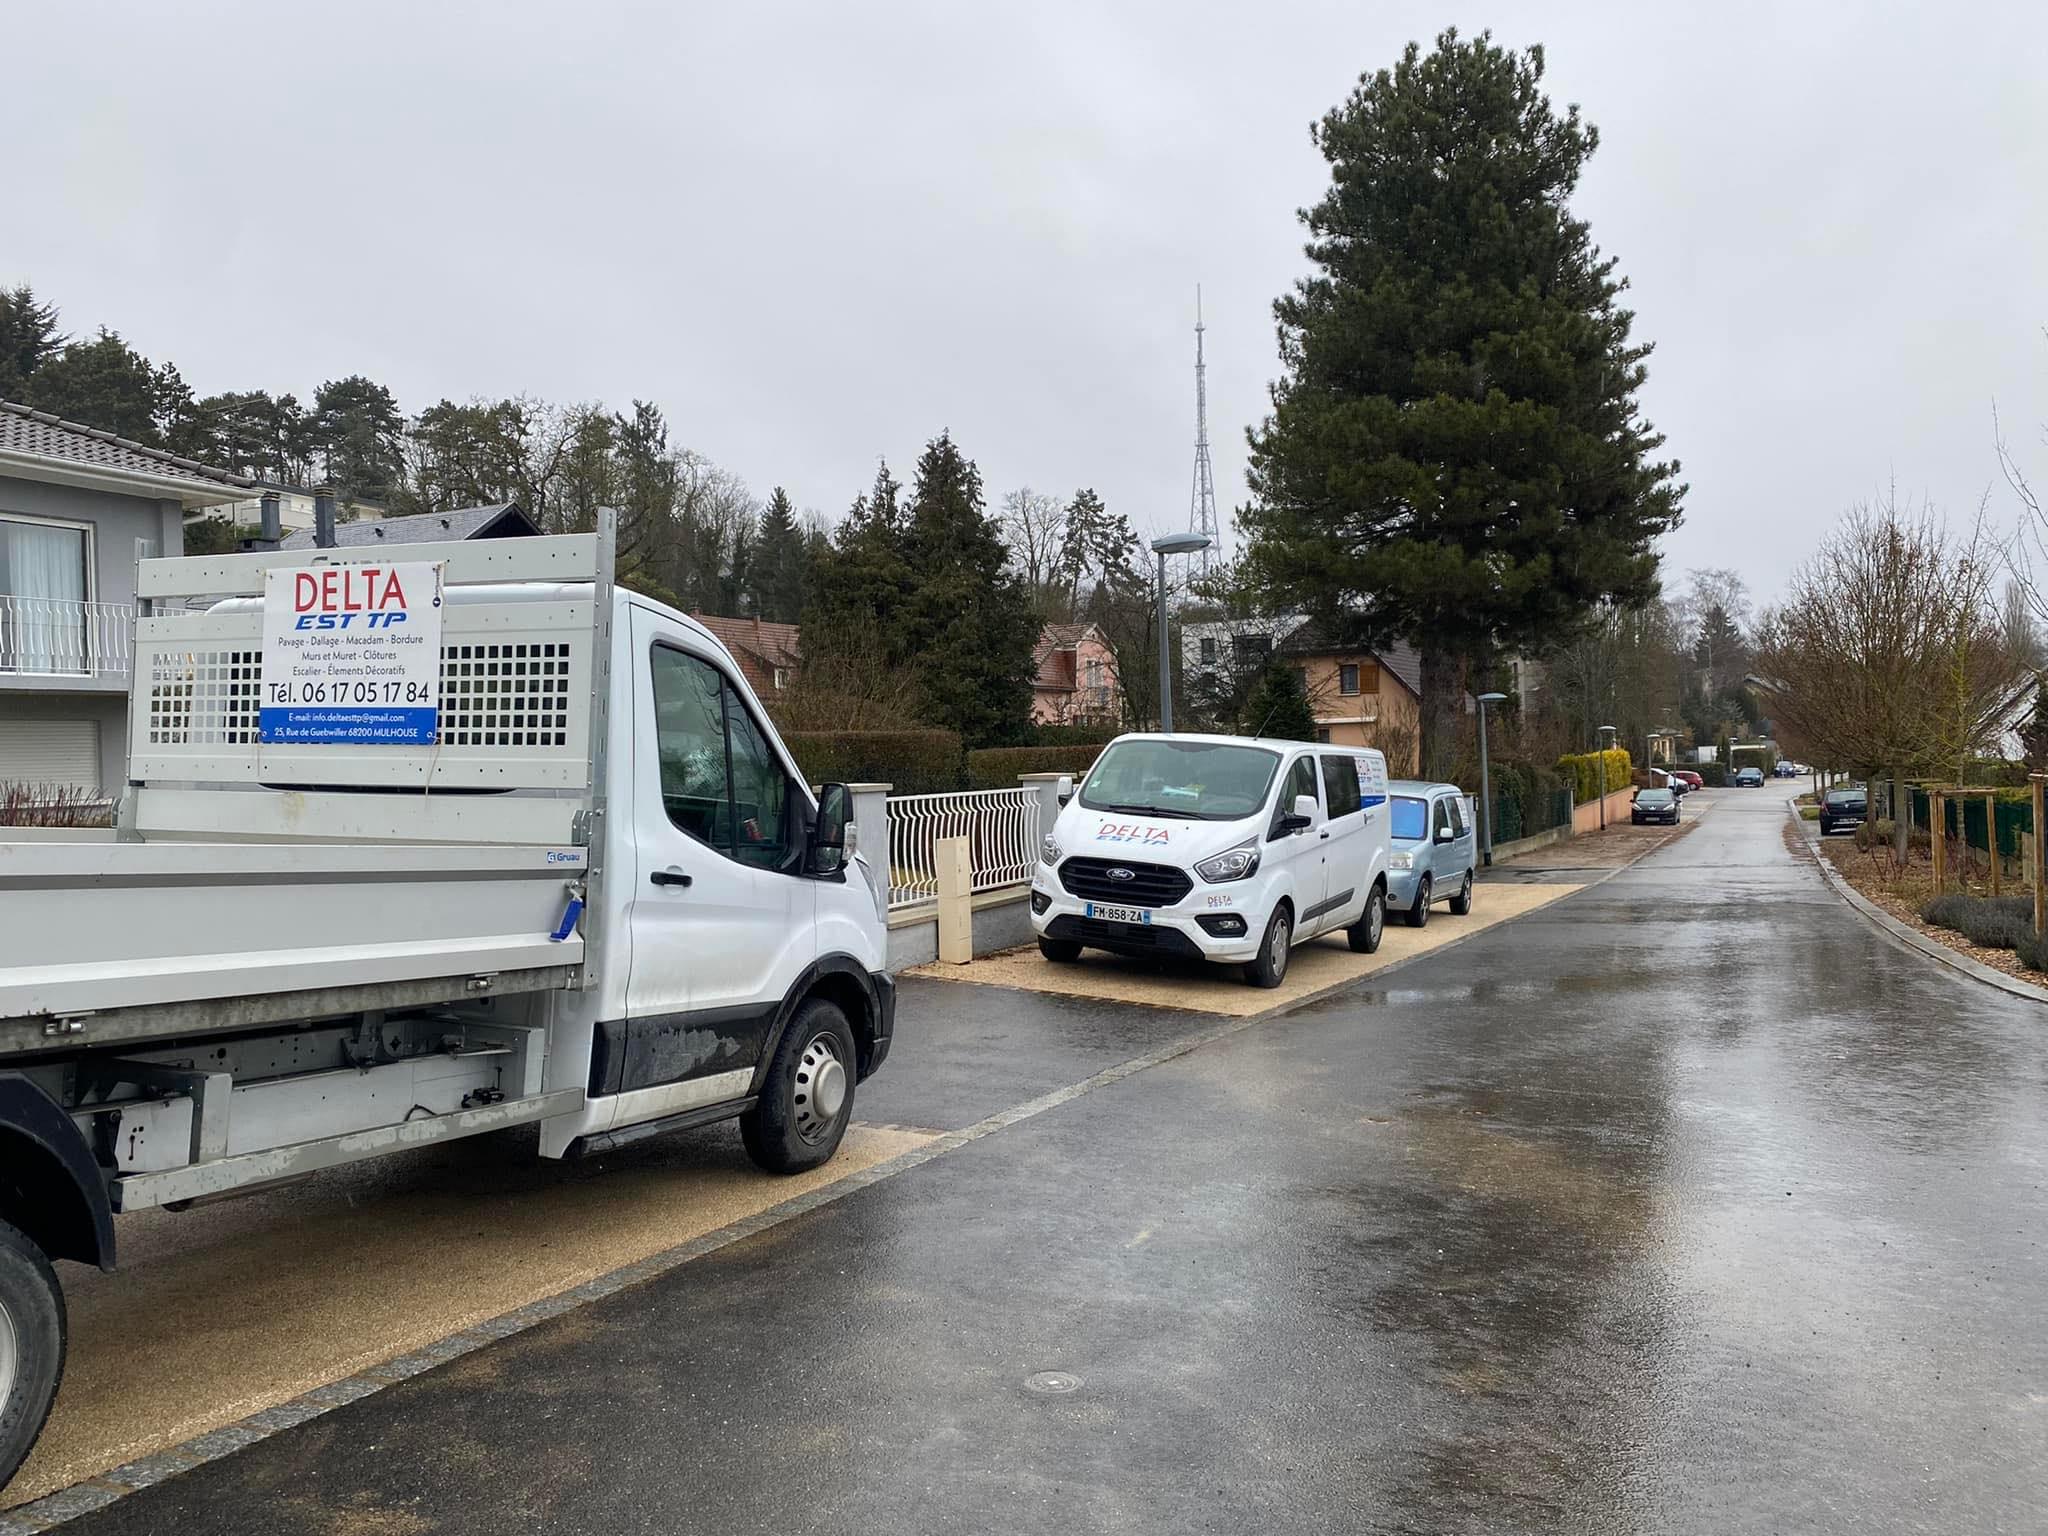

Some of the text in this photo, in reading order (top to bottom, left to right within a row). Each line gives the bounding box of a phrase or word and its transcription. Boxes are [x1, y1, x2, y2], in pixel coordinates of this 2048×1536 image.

[295, 568, 407, 612] DELTA
[295, 612, 407, 630] EST TP
[278, 636, 304, 648] Pavage
[311, 635, 339, 647] Dallage
[346, 634, 384, 645] Macadam
[391, 633, 423, 644] Bordure
[302, 651, 321, 661] Murs
[333, 651, 357, 660] Muret
[363, 649, 397, 660] Clôtures
[293, 665, 321, 676] Escalier
[365, 664, 406, 675] Décoratifs
[268, 681, 430, 703] Tél. 06 17 05 17 84
[274, 727, 285, 737] 25,
[286, 727, 299, 736] Rue
[300, 727, 309, 736] de
[348, 727, 373, 737] 68200
[373, 727, 419, 737] MULHOUSE
[1098, 823, 1169, 841] DELTA
[557, 853, 580, 861] Gruau
[1207, 896, 1232, 905] DELTA
[1093, 906, 1143, 923] FM-858-ZA
